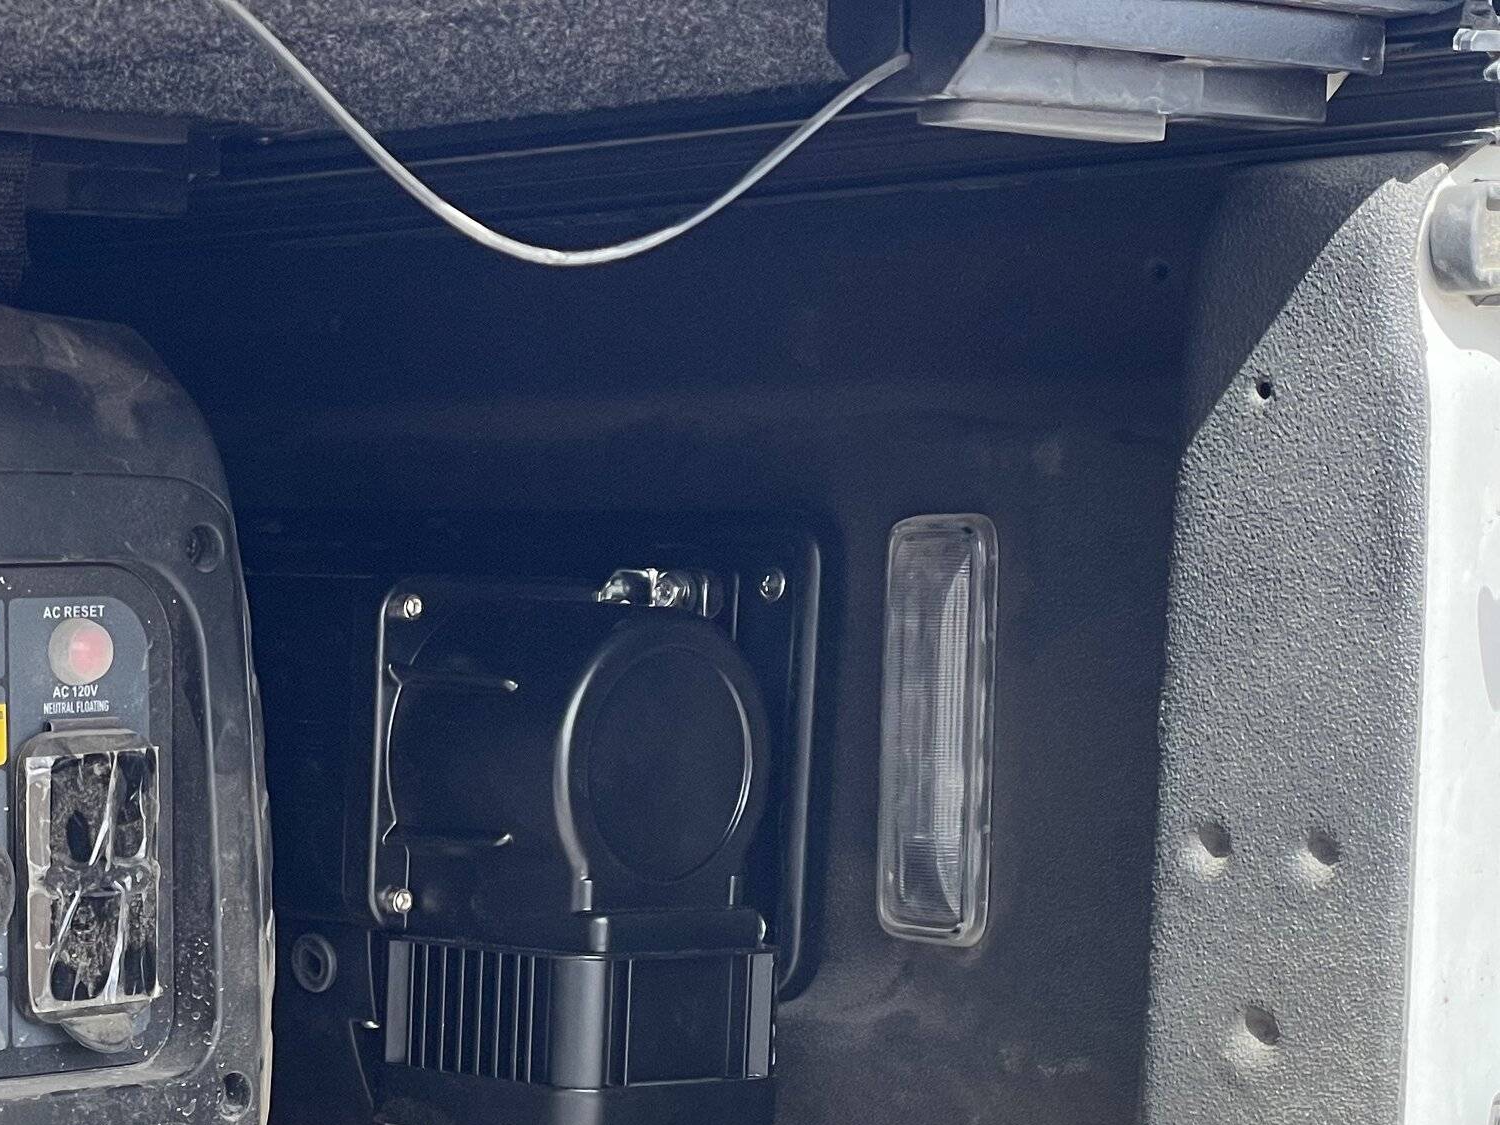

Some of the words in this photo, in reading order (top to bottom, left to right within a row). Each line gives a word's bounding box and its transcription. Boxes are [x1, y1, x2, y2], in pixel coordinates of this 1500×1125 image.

[43, 606, 61, 619] AC
[63, 604, 106, 618] RESET
[52, 685, 70, 699] AC
[71, 684, 98, 698] 120V
[43, 702, 75, 715] NEUTRAL
[76, 700, 110, 713] FLOATING
